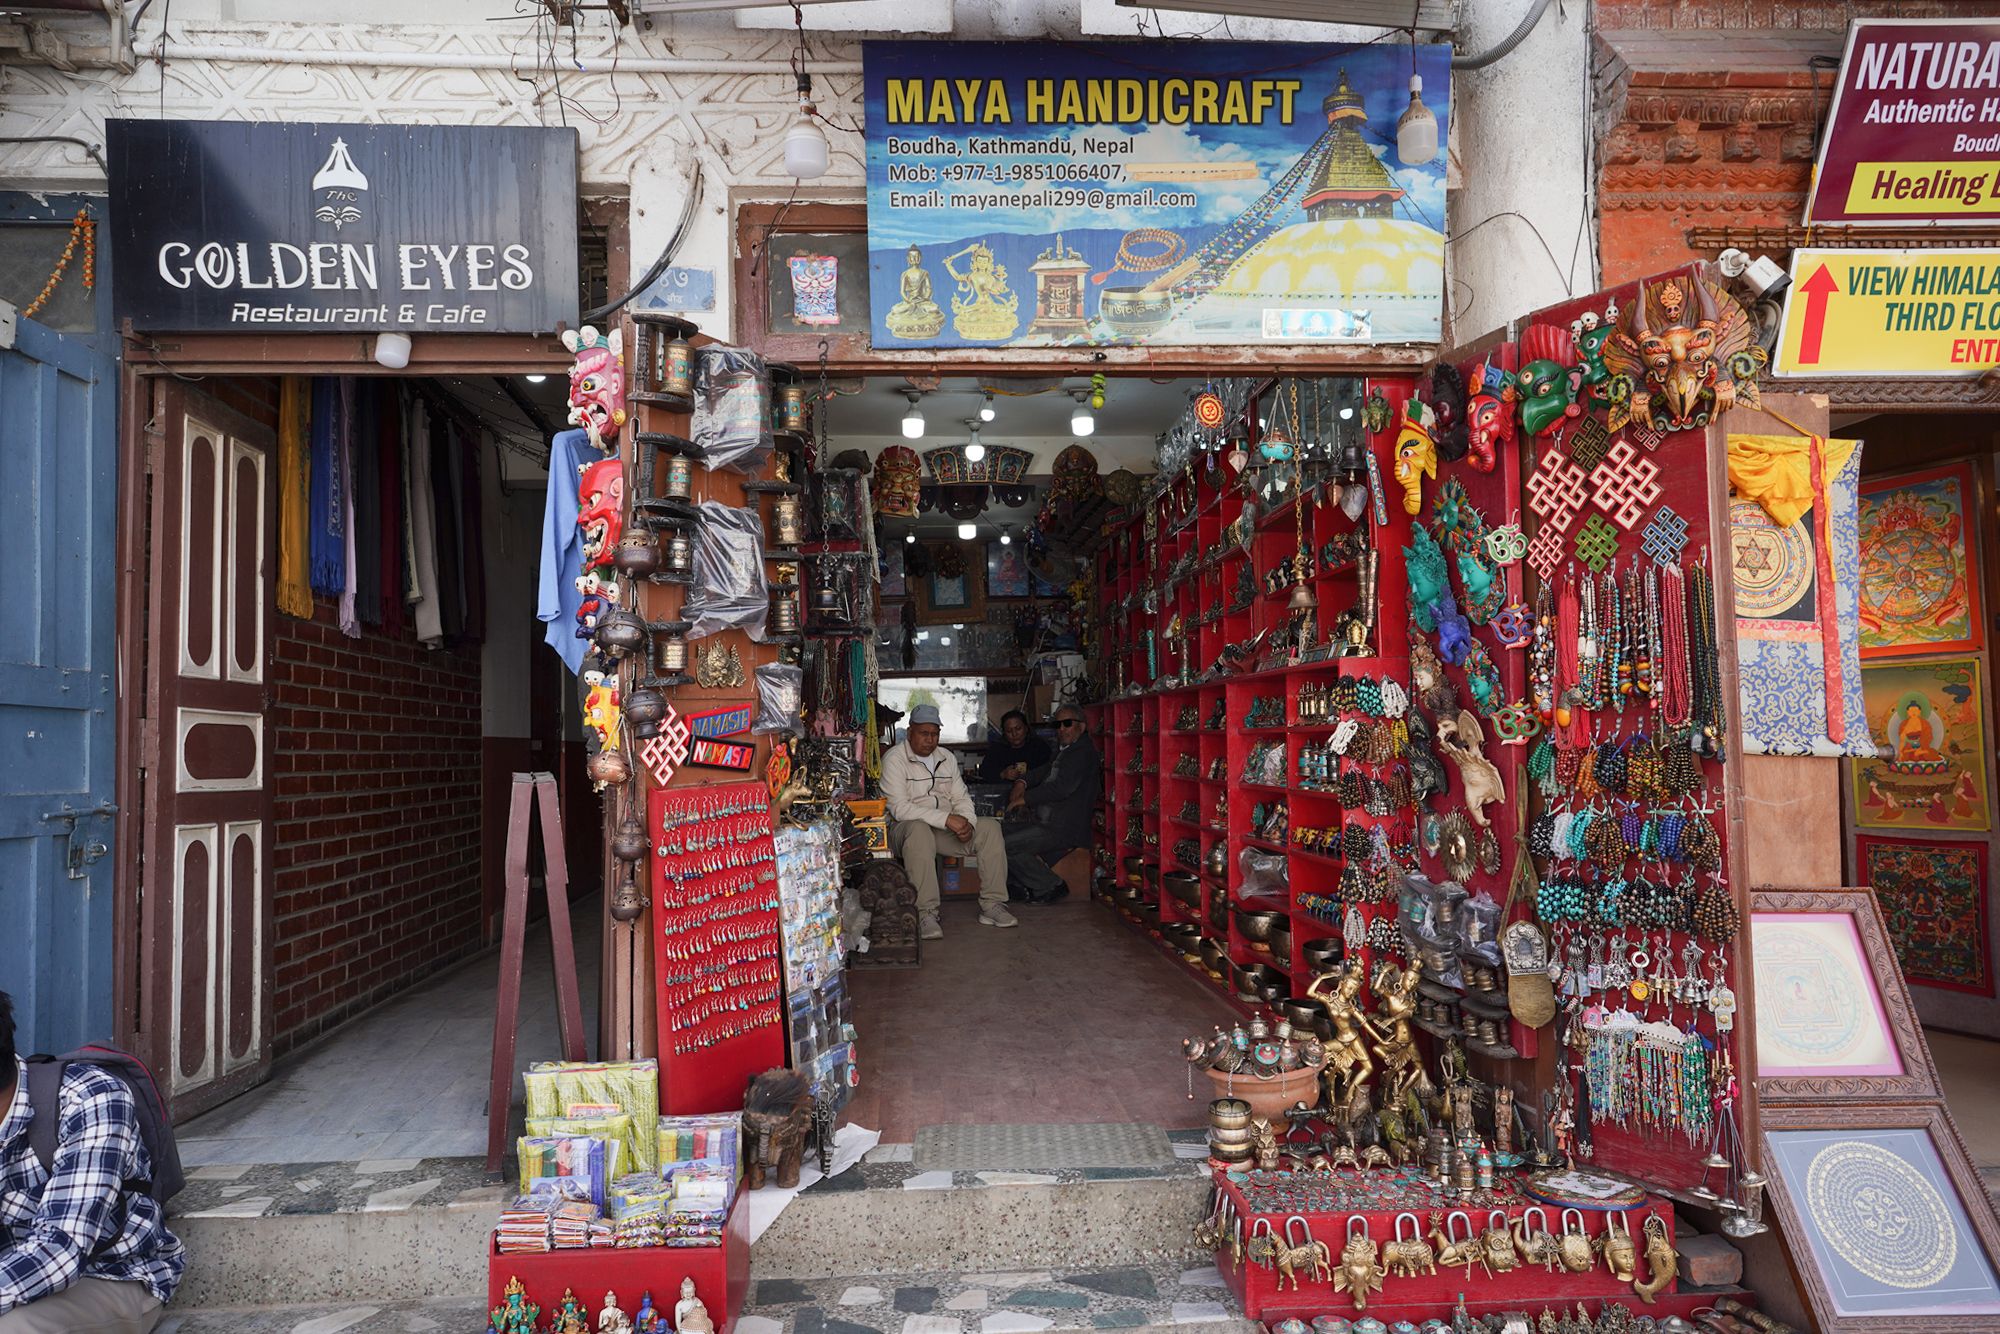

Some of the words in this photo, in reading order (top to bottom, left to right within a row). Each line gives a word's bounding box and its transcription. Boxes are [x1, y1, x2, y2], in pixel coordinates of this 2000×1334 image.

[1855, 41, 2000, 90] NATURA
[886, 78, 1011, 123] MAYA
[1026, 78, 1300, 124] HANDICRAFT
[1863, 98, 1976, 124] Authentic
[888, 137, 962, 156] Boudha,
[968, 137, 1077, 156] Kathmandu,
[1083, 137, 1135, 156] Nepal
[889, 164, 936, 181] Mob:
[941, 163, 1127, 182] +977-1-9851066407,
[890, 191, 944, 208] Email:
[950, 189, 1196, 210] mayanepali299@gmail.com
[1871, 170, 1989, 206] Healing
[158, 241, 378, 290] GOLDEN
[400, 243, 534, 290] EYES
[1848, 265, 1908, 296] VIEW
[231, 302, 388, 323] Restaurant
[398, 304, 415, 324] &
[425, 303, 487, 325] Cafe
[1885, 302, 1955, 331] THIRD
[692, 708, 749, 737] NAMASTE
